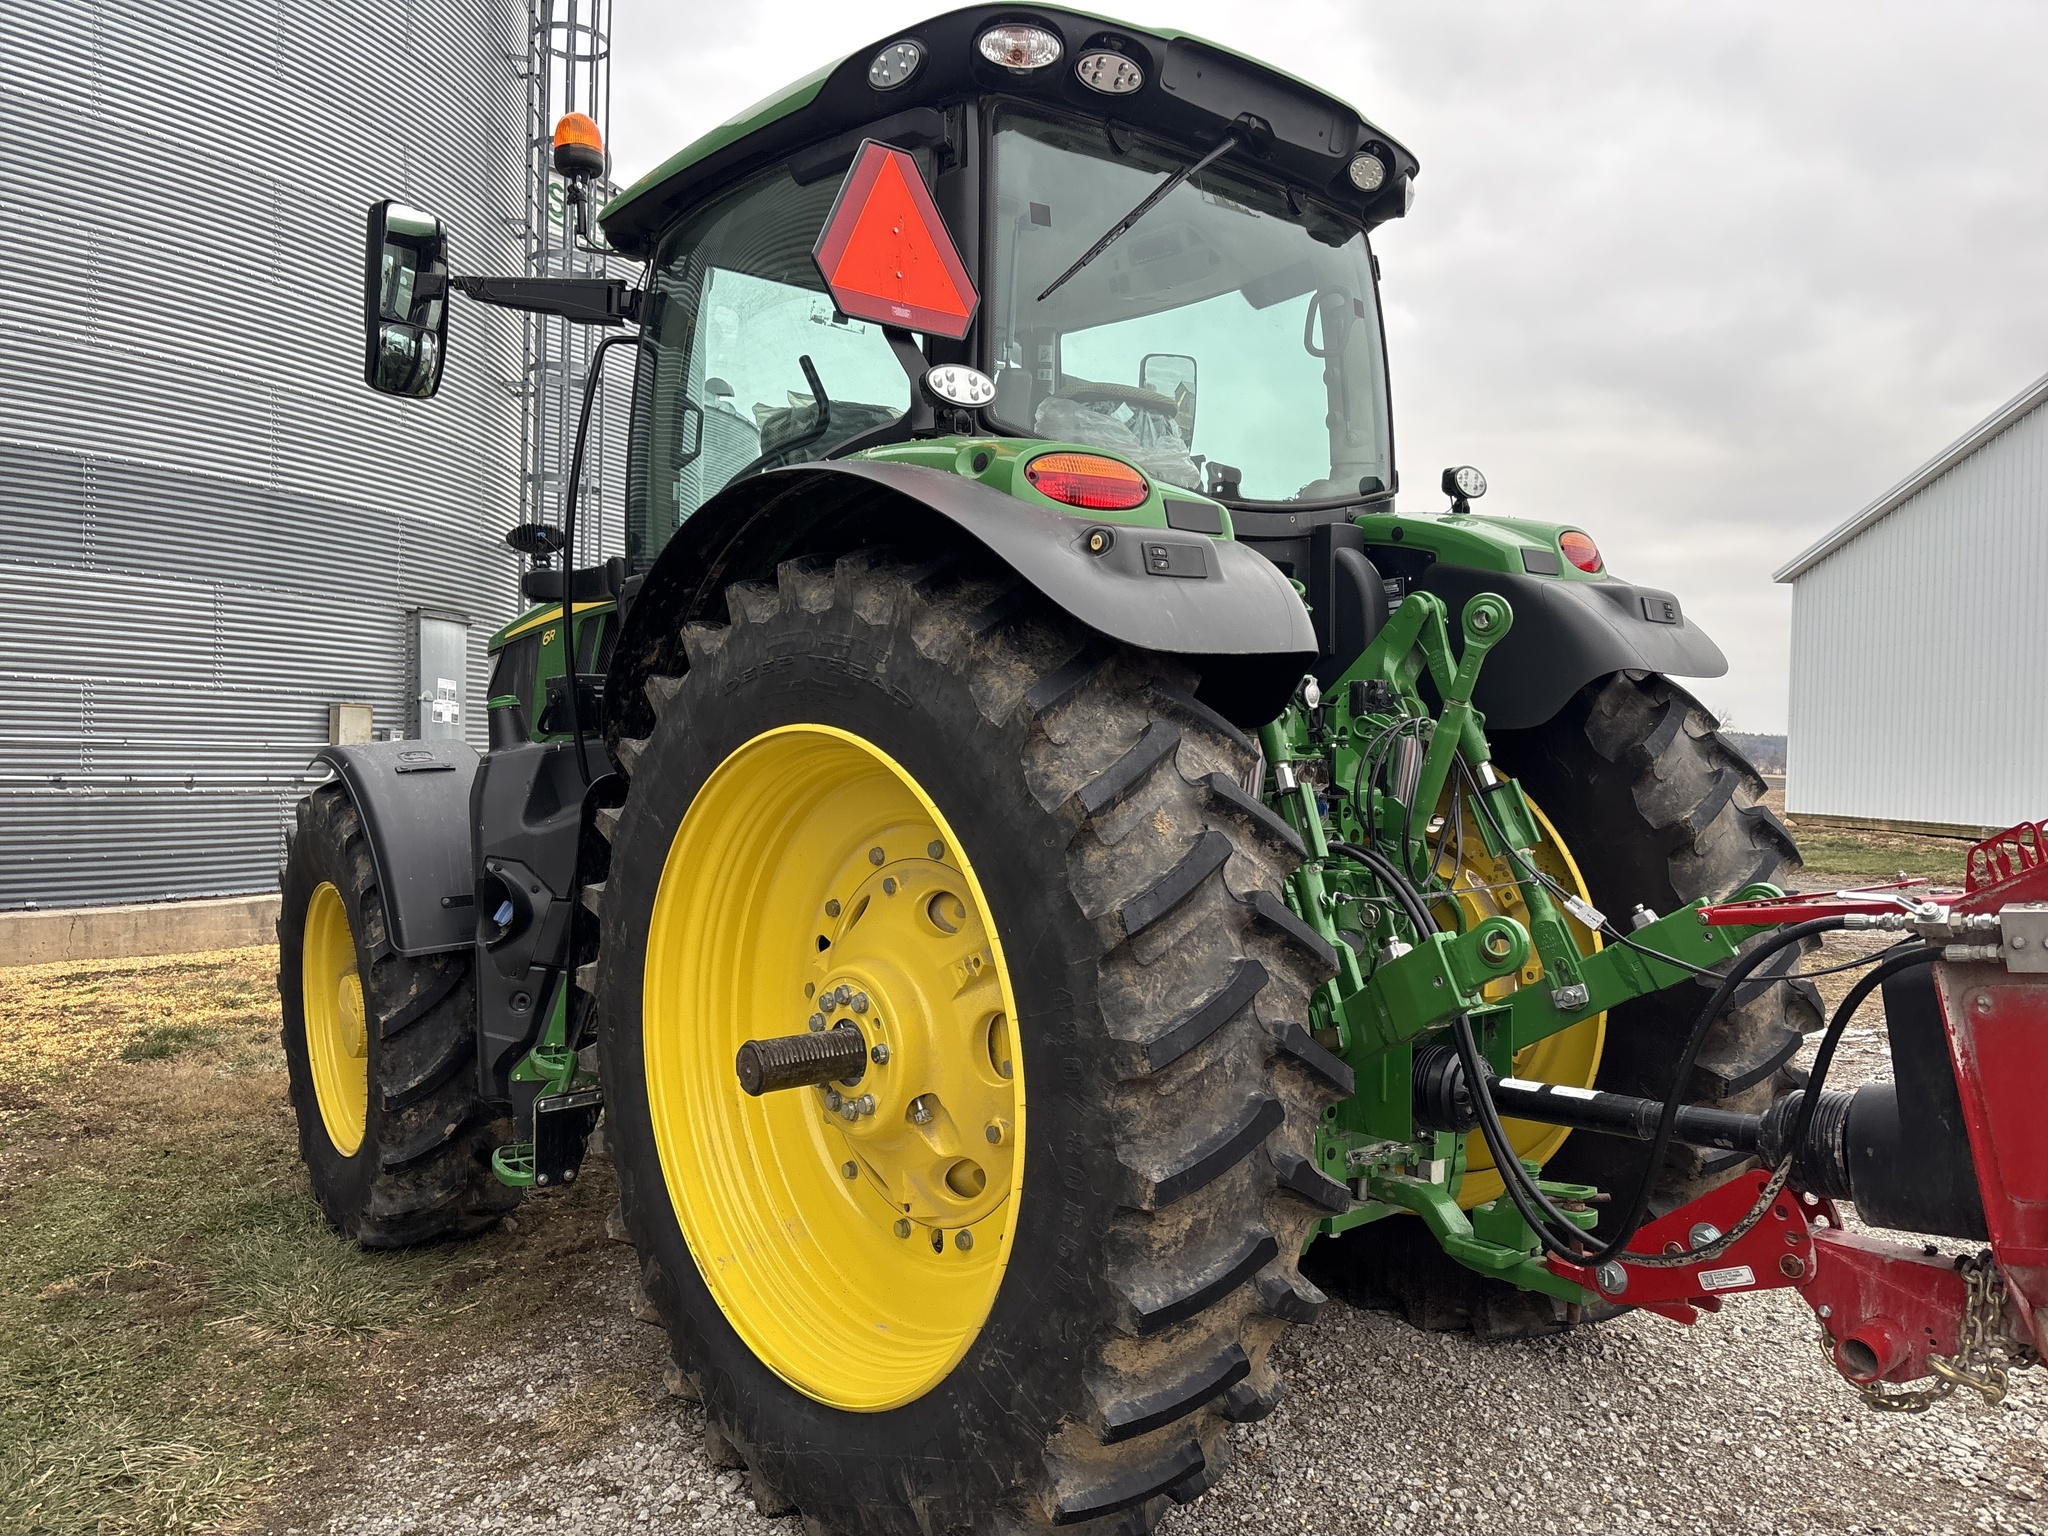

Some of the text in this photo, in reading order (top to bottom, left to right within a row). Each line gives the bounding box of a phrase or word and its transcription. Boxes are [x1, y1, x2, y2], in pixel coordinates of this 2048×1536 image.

[542, 629, 556, 646] 6R
[723, 654, 914, 709] DEEP TREAD
